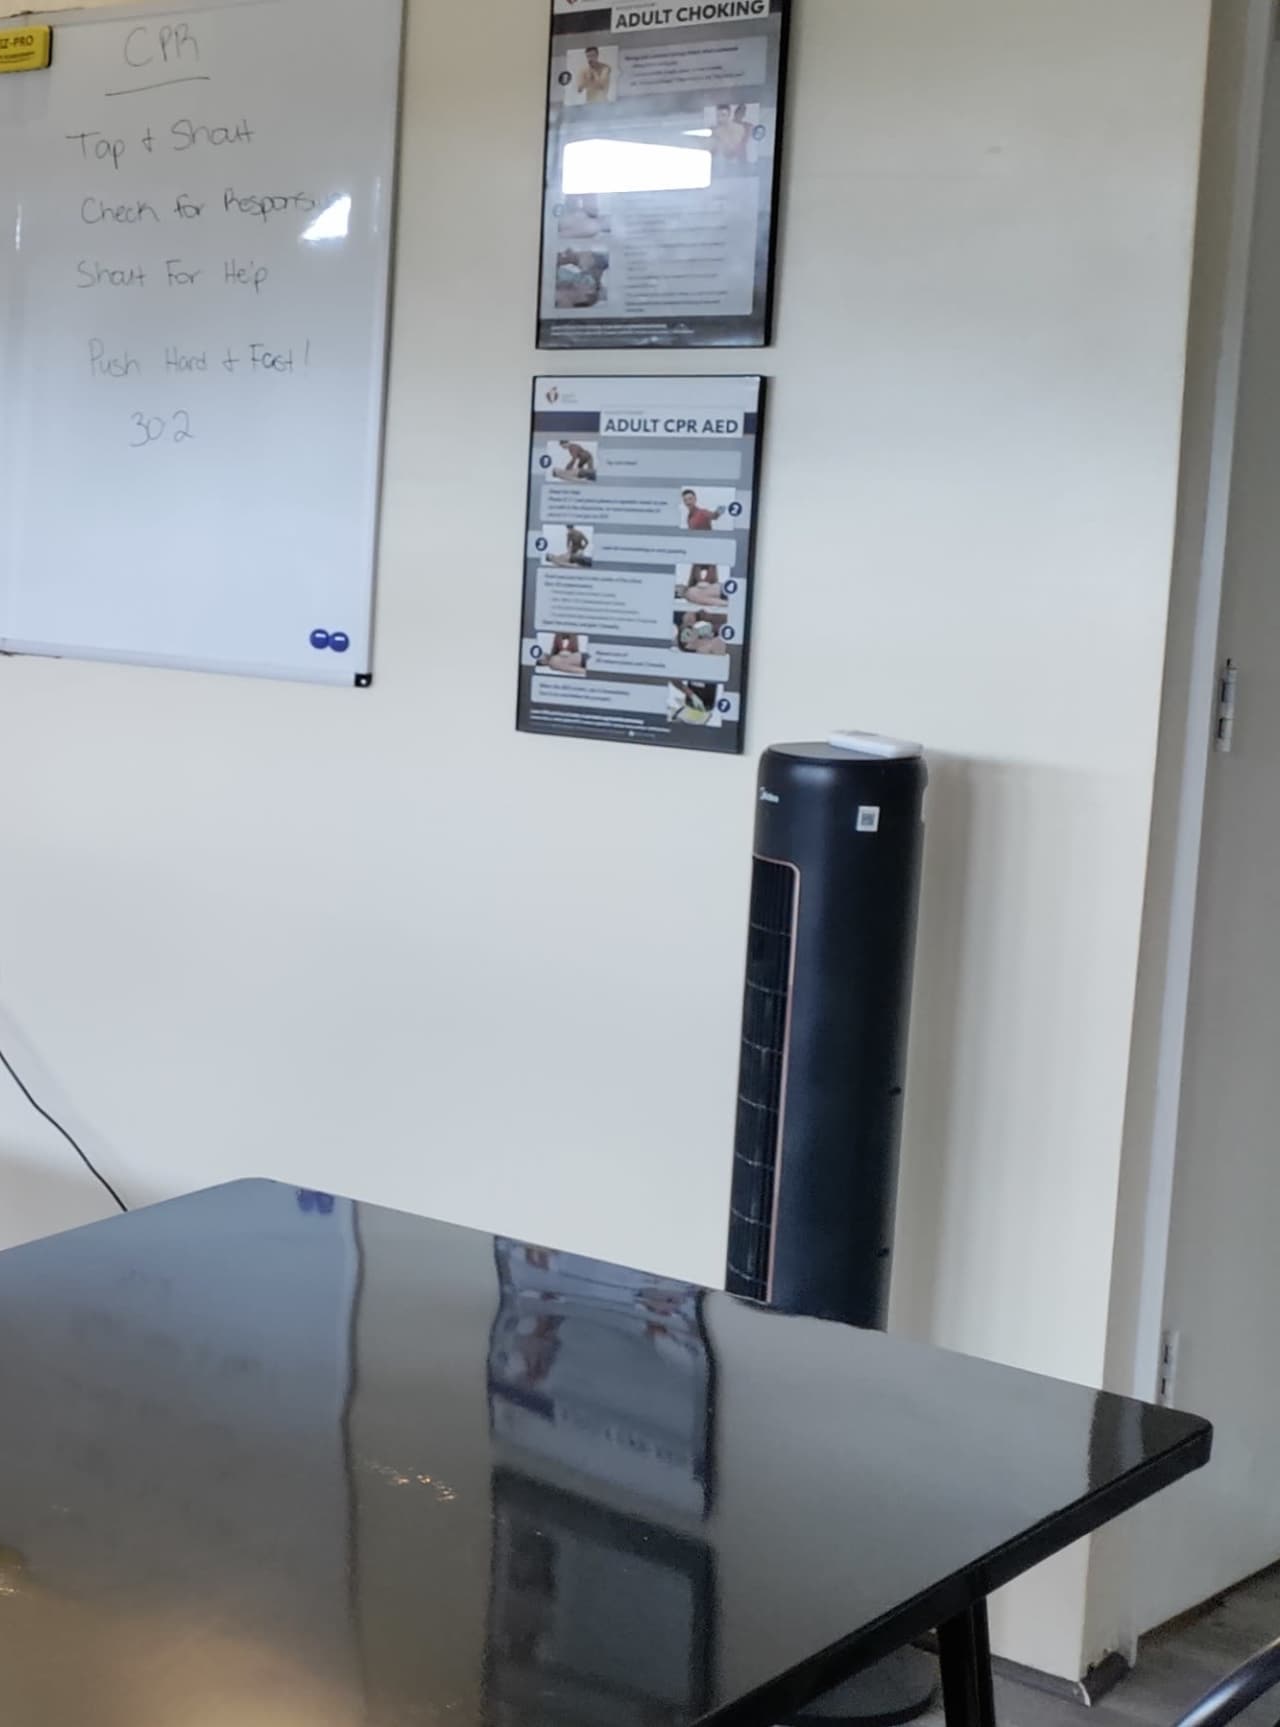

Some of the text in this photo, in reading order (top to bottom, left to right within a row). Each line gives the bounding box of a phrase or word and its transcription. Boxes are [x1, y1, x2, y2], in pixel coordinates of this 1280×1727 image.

[615, 0, 765, 29] ADULT CHOKING
[124, 23, 200, 67] CPR
[65, 130, 125, 169] Tap
[171, 118, 255, 151] Shout
[81, 196, 160, 224] Check
[77, 259, 146, 288] Shout
[224, 258, 269, 294] Help
[88, 337, 140, 378] Push
[165, 346, 208, 371] Hard
[604, 418, 739, 434] ADULT CPR AED
